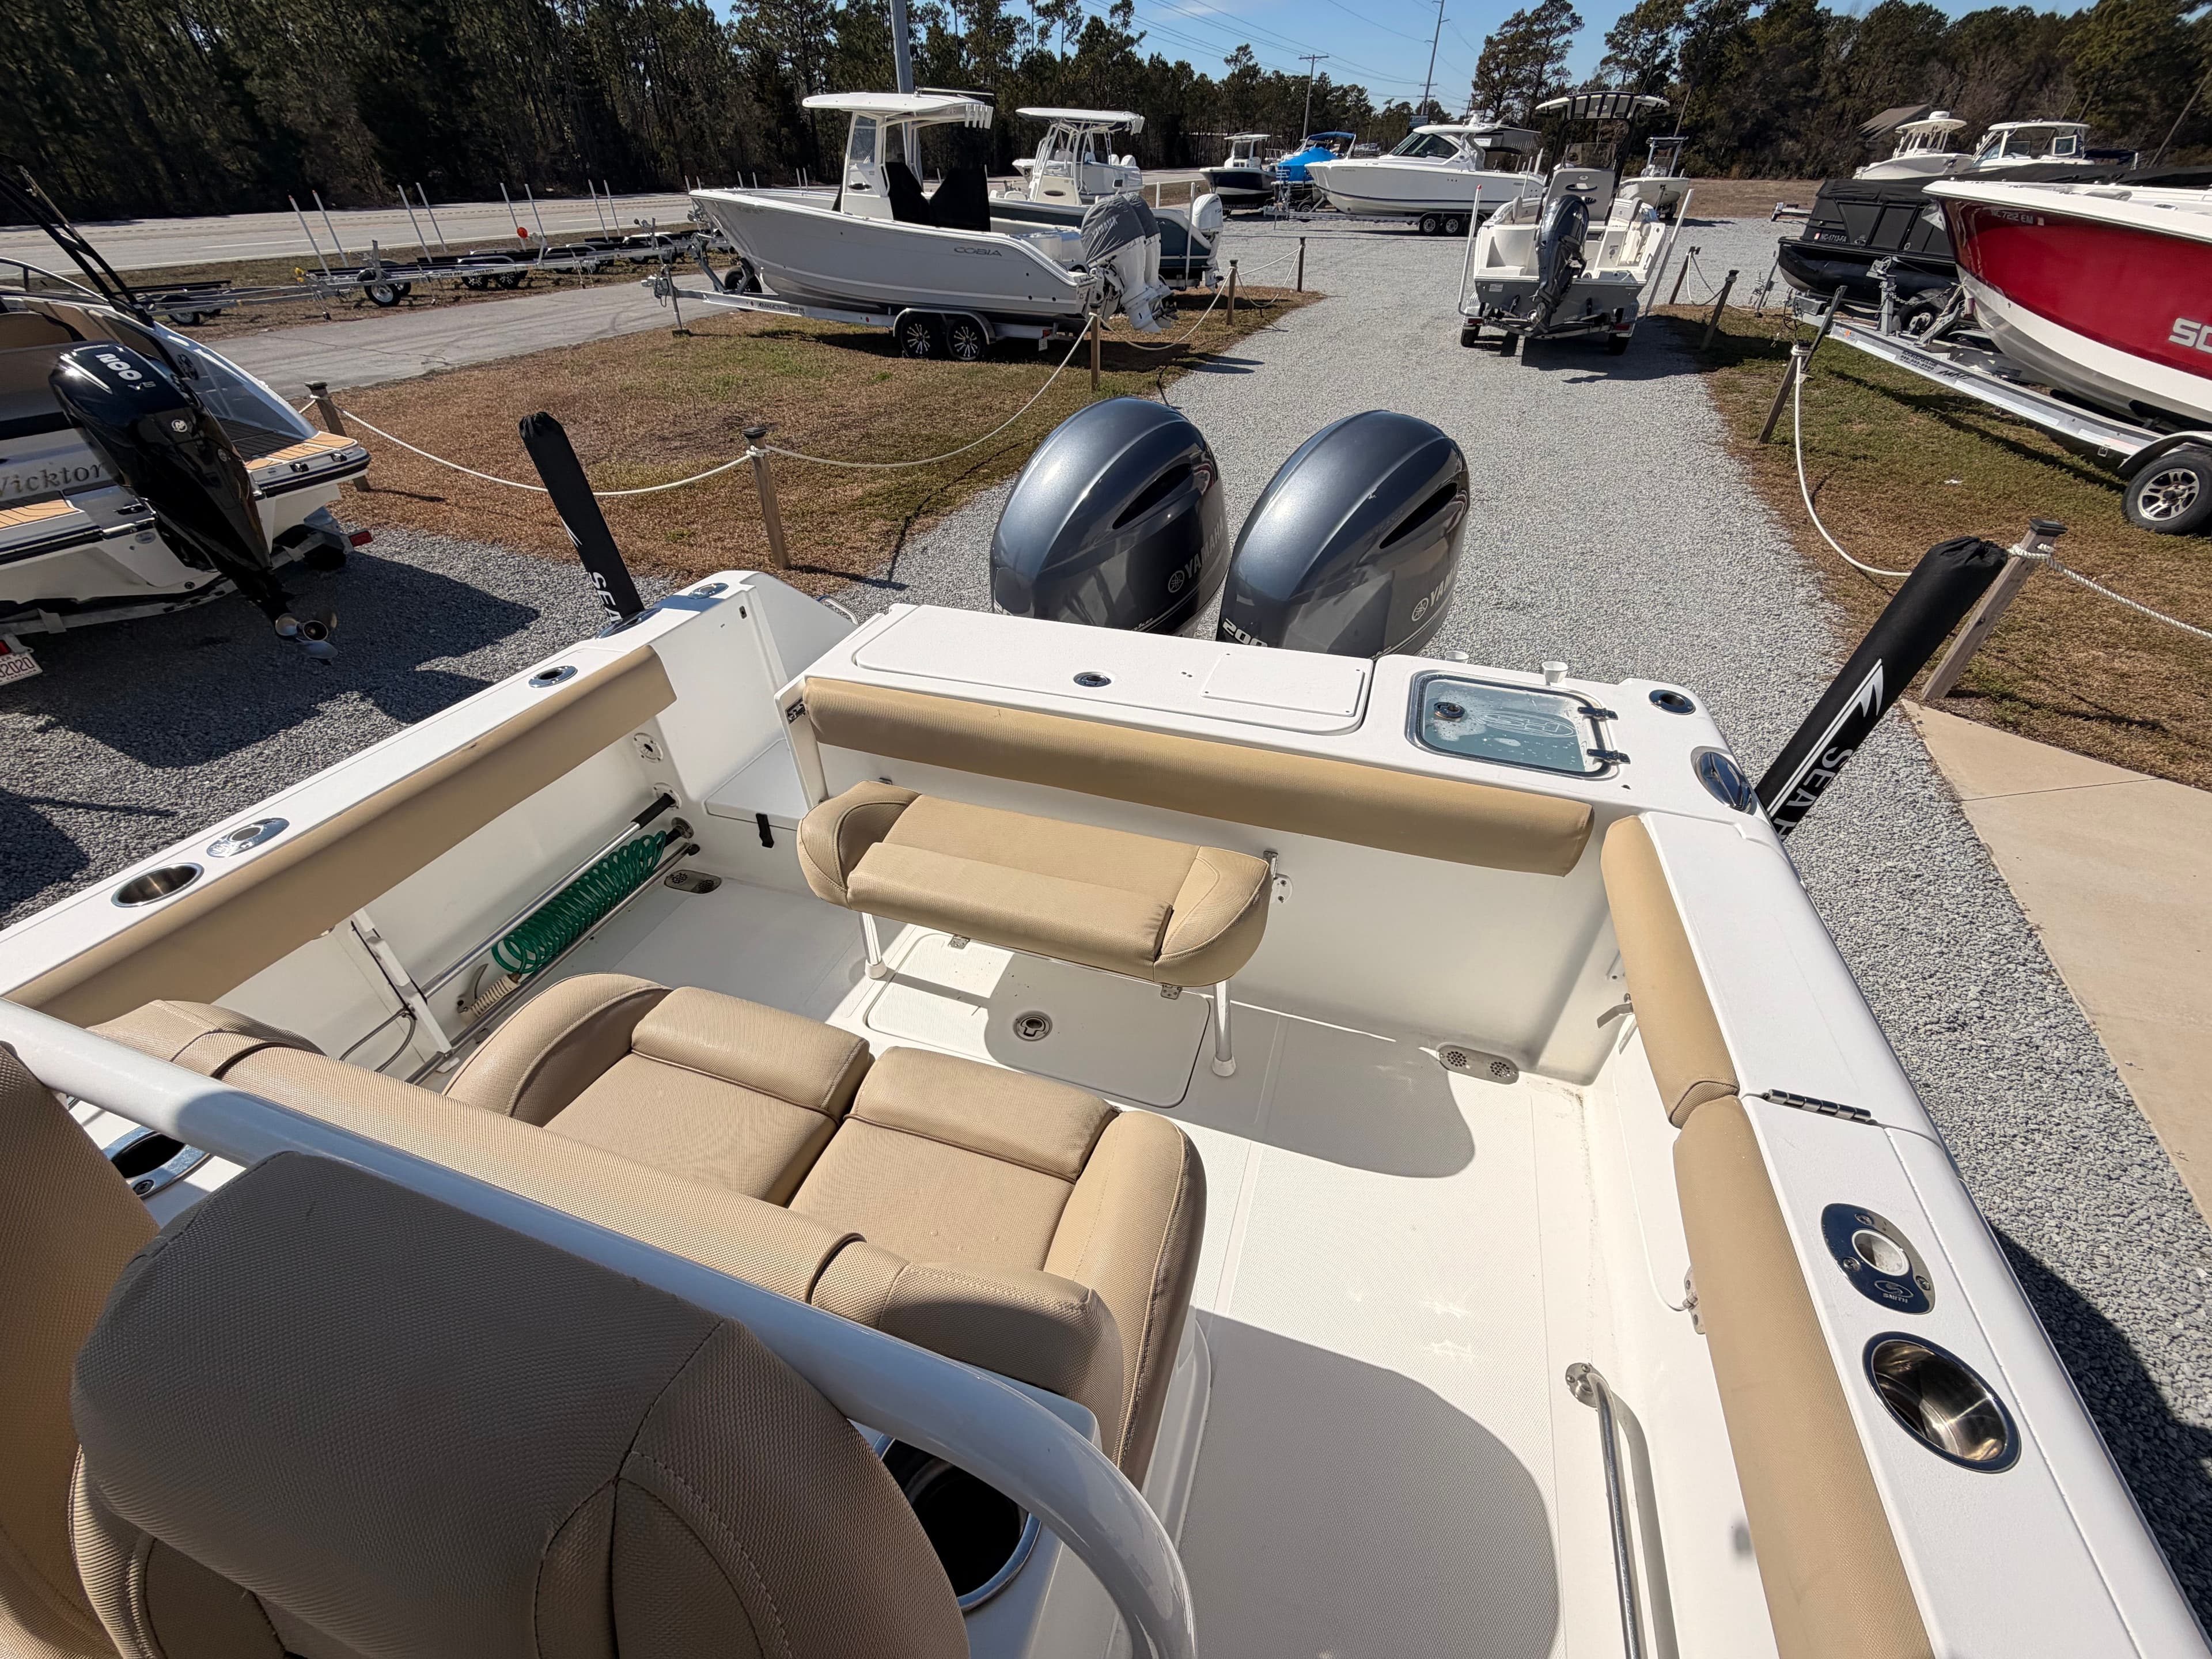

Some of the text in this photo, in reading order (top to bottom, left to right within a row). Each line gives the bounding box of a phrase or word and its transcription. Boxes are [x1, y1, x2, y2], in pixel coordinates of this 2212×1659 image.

[953, 247, 1002, 257] COBIA
[95, 353, 143, 380] 200
[1184, 516, 1224, 579] YAMAHA
[588, 571, 623, 622] SEA
[1786, 747, 1854, 807] SEA
[1883, 1293, 1908, 1304] SMITH
